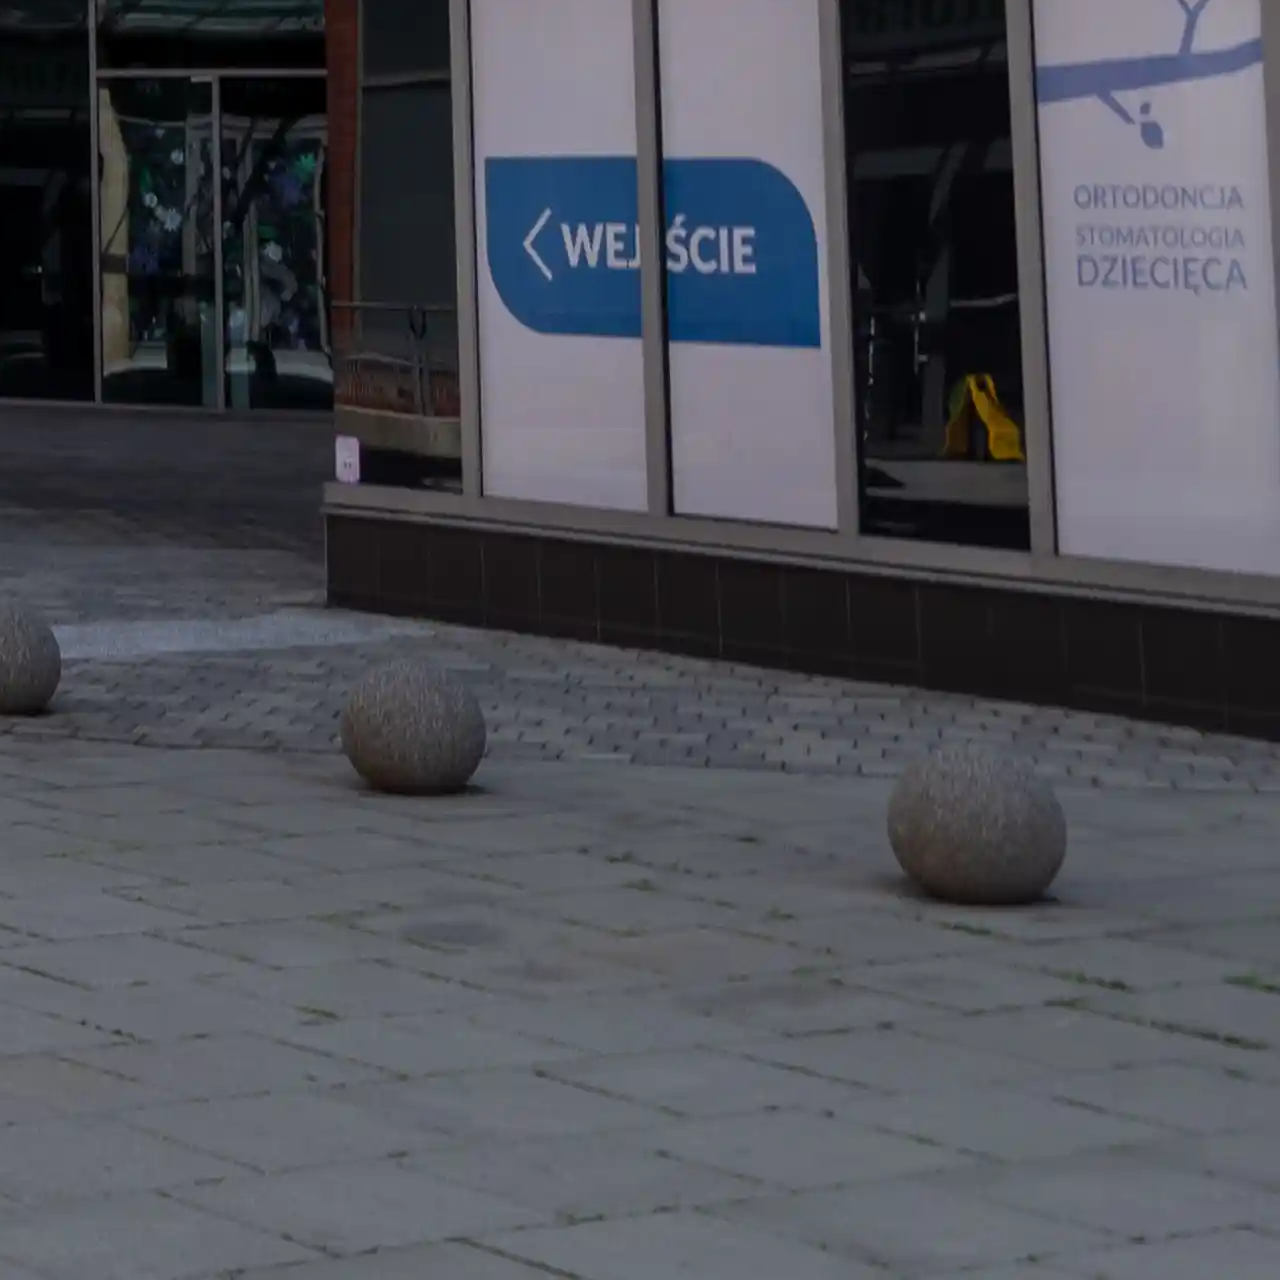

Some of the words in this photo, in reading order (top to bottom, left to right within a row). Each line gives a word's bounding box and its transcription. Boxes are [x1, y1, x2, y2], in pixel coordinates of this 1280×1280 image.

[1073, 183, 1244, 210] ORTODONCJA
[1075, 223, 1246, 249] STOMATOLOGIA
[1076, 253, 1248, 297] DZIECIĘCA
